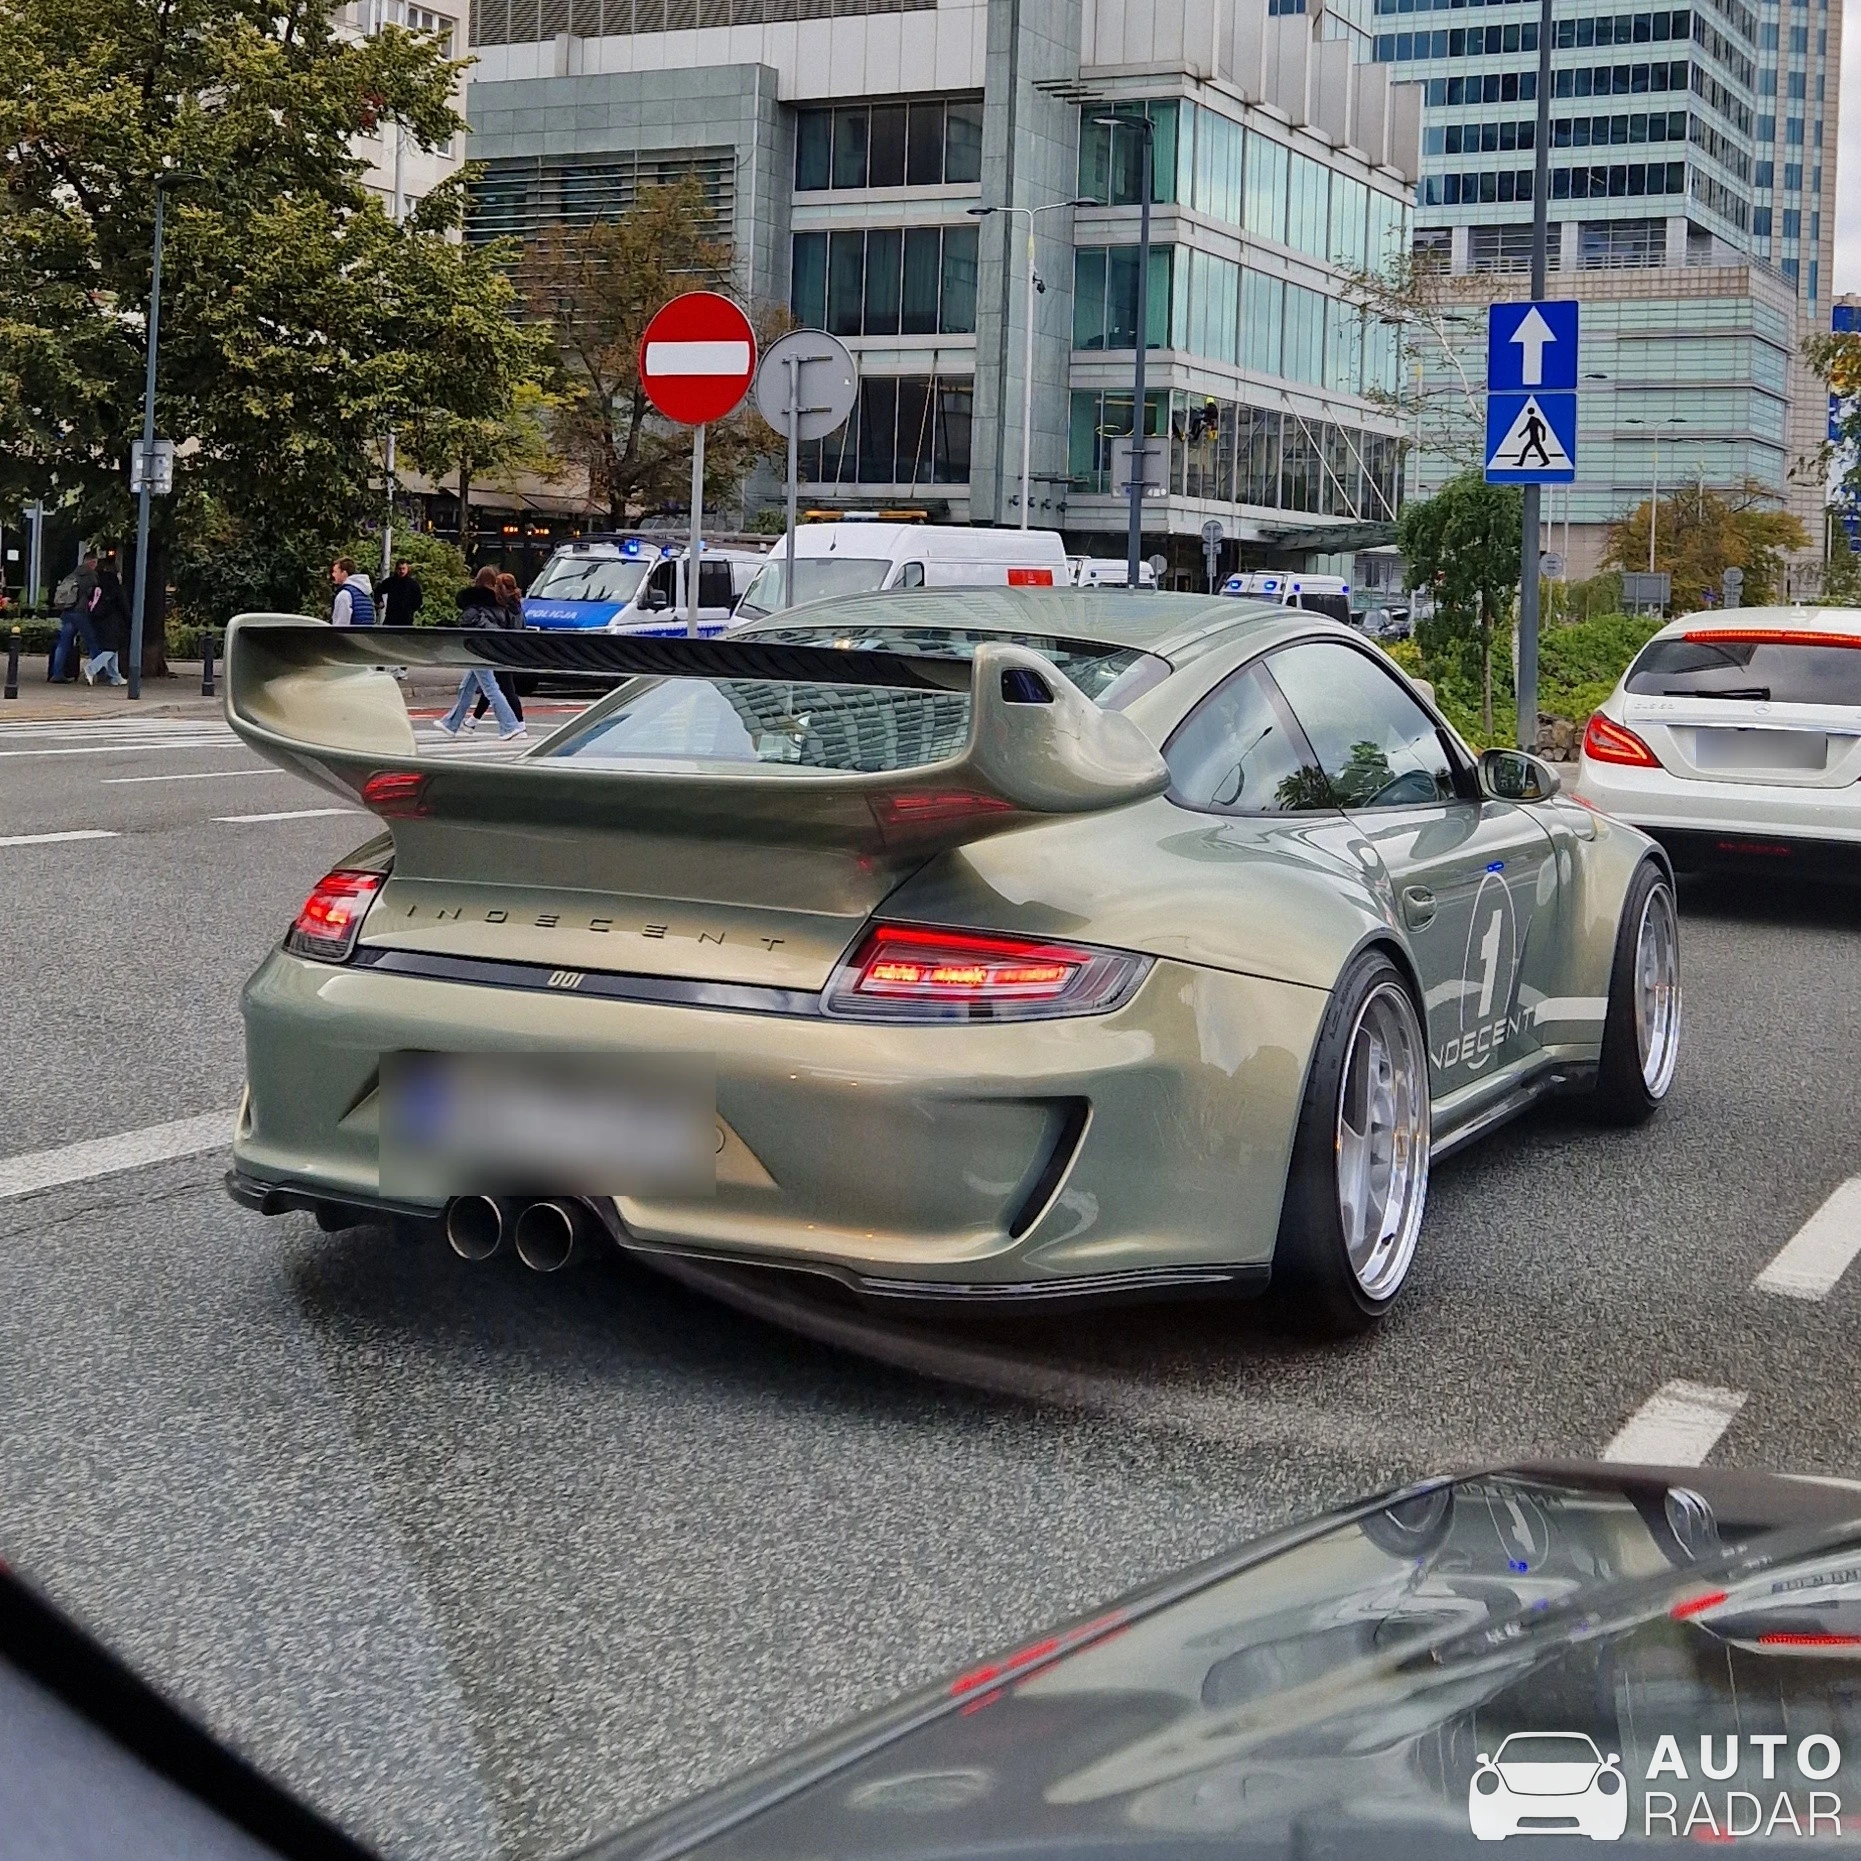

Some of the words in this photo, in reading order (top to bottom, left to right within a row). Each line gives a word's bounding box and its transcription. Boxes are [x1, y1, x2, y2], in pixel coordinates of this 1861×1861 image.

[525, 609, 577, 619] POLICJA
[406, 904, 784, 951] INDECENT
[1478, 909, 1502, 1018] 1
[1430, 1007, 1535, 1070] NDECENT
